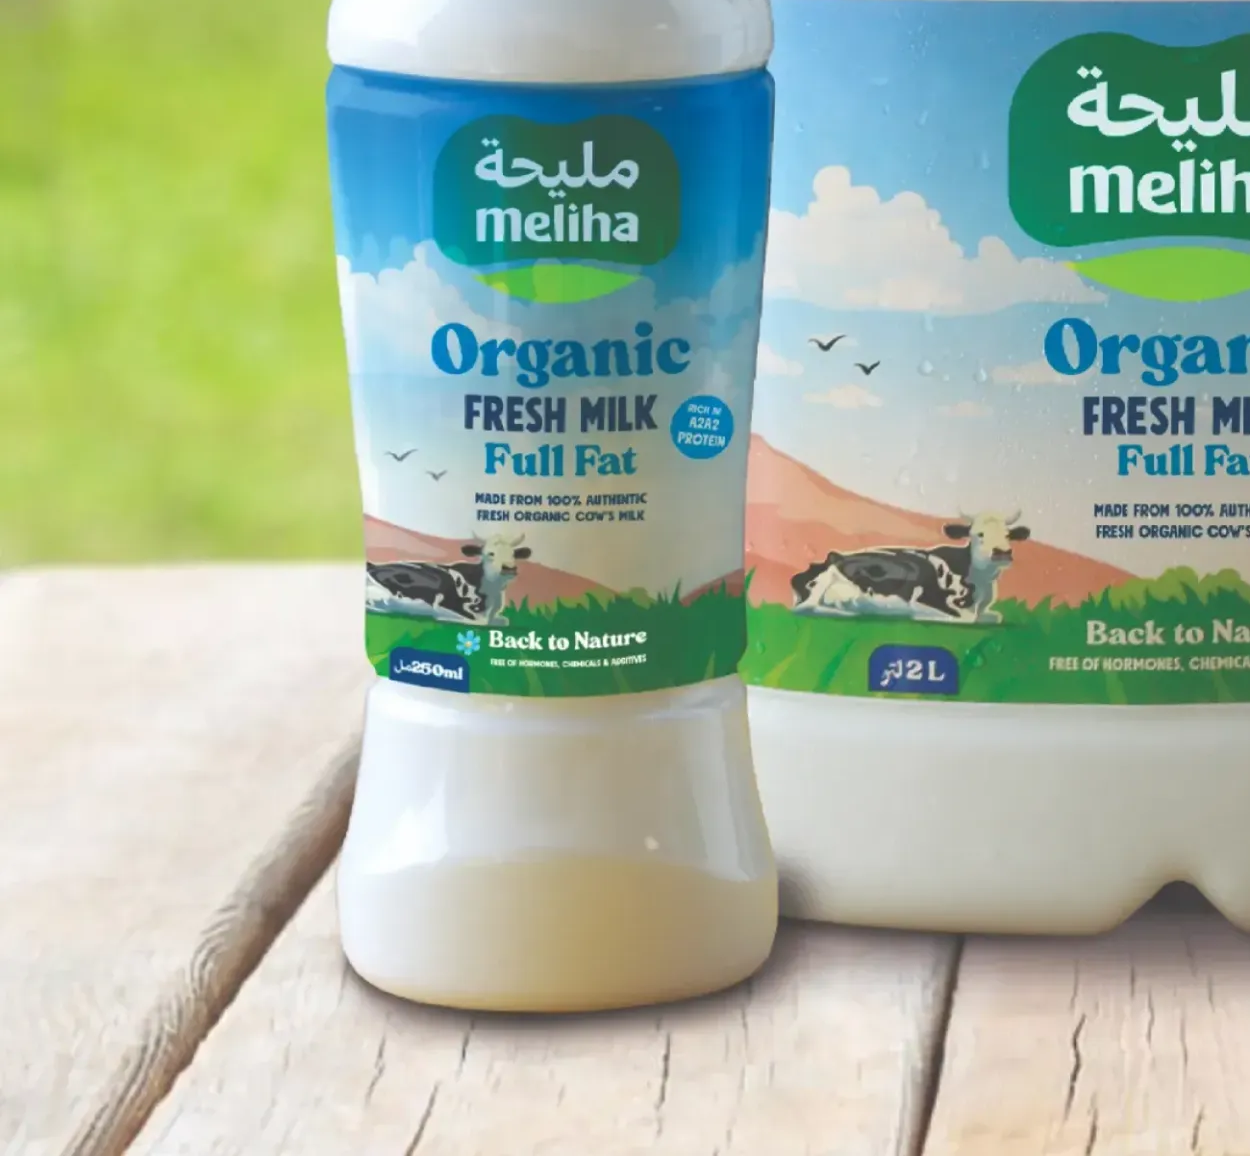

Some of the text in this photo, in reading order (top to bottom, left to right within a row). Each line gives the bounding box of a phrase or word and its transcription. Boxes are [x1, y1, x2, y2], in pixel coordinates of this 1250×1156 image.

[475, 138, 640, 198] مليحة
[476, 203, 640, 242] meliha
[431, 321, 690, 388] Organic
[464, 394, 658, 433] FRESH MILK
[689, 416, 720, 431] A2A2
[1083, 396, 1195, 436] FRESH
[677, 431, 726, 447] PROTEIN
[484, 442, 637, 477] Full Fat
[1117, 444, 1195, 476] Full
[475, 493, 648, 506] MADE FROM 100% AUTHENTIC
[1094, 504, 1128, 517] MADE
[1133, 504, 1170, 517] FROM
[1175, 504, 1214, 517] 100%
[476, 510, 645, 522] FRESH ORGANIC COW'S MILK
[1096, 525, 1133, 538] FRESH
[1139, 525, 1203, 538] ORGANIC
[489, 630, 648, 651] Back to Nature
[1086, 620, 1166, 646] Back
[1174, 622, 1204, 645] to
[1050, 657, 1079, 671] FREE
[1082, 657, 1100, 671] OF
[1102, 657, 1185, 672] HORMONES,
